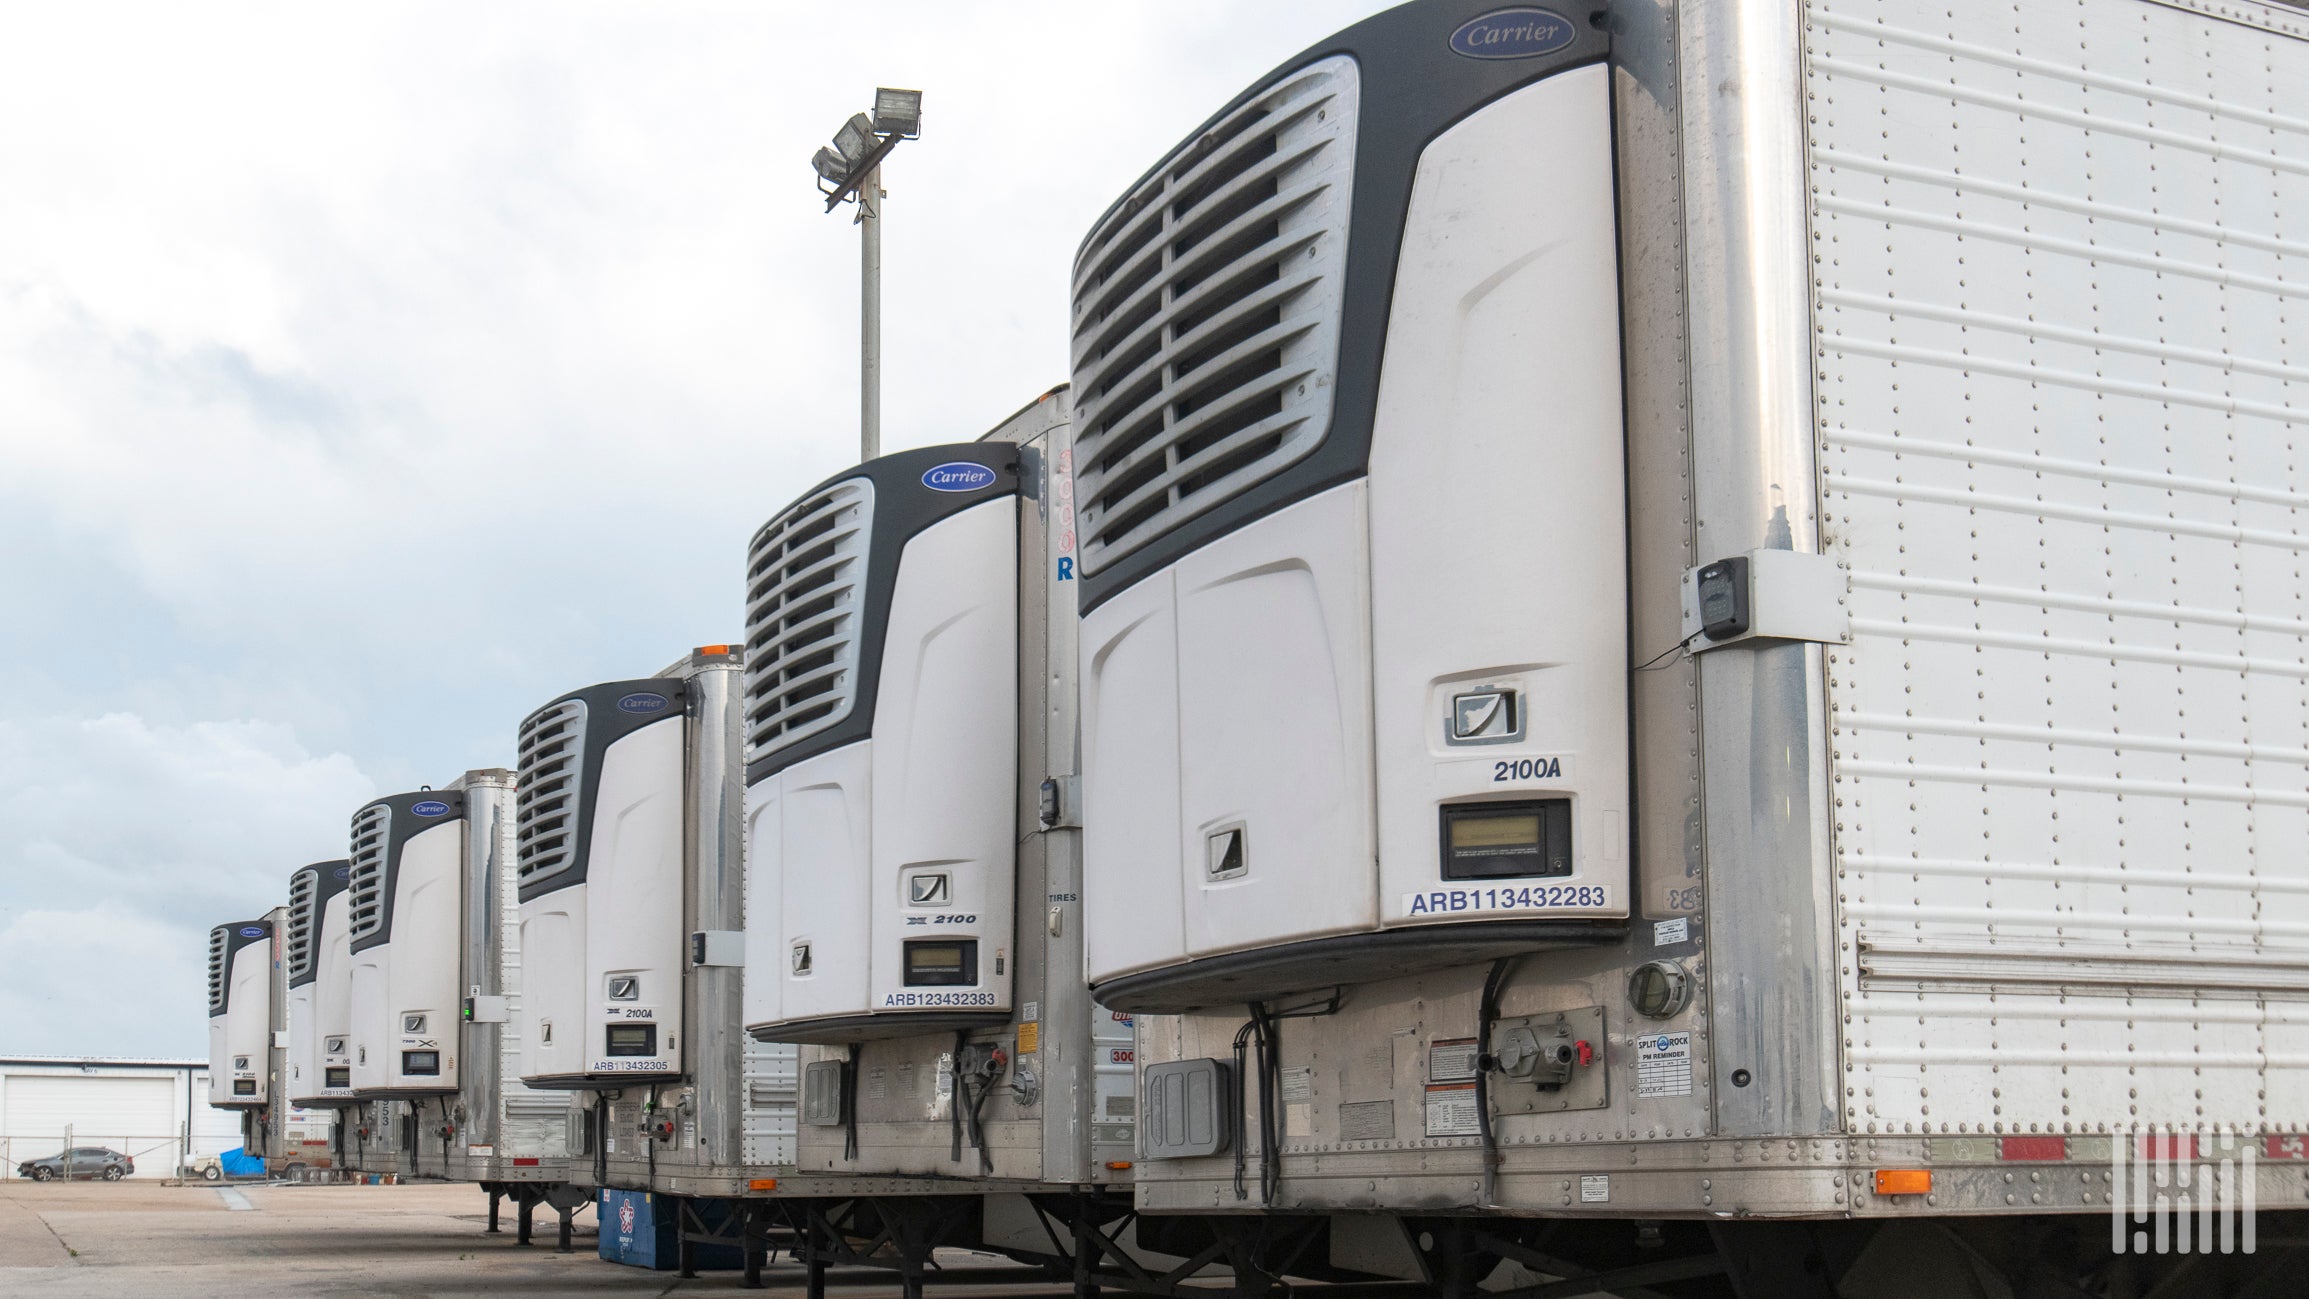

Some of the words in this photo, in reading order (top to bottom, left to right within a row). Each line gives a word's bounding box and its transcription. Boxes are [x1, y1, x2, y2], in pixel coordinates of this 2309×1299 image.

[1467, 22, 1559, 47] Carrier
[931, 470, 986, 484] Carrier
[623, 699, 662, 708] Carrier
[1494, 757, 1562, 782] 2100A
[415, 805, 446, 814] Carrier
[1048, 893, 1077, 902] TIRES
[1410, 886, 1605, 914] ARB113432283
[933, 914, 977, 924] 2100
[885, 992, 995, 1006] ARB123432383
[626, 1009, 653, 1018] 2100A
[1638, 1040, 1657, 1049] SPLIT
[1669, 1037, 1689, 1046] ROCK
[1652, 1051, 1685, 1060] REMINDER
[593, 1061, 669, 1071] ARB113432305
